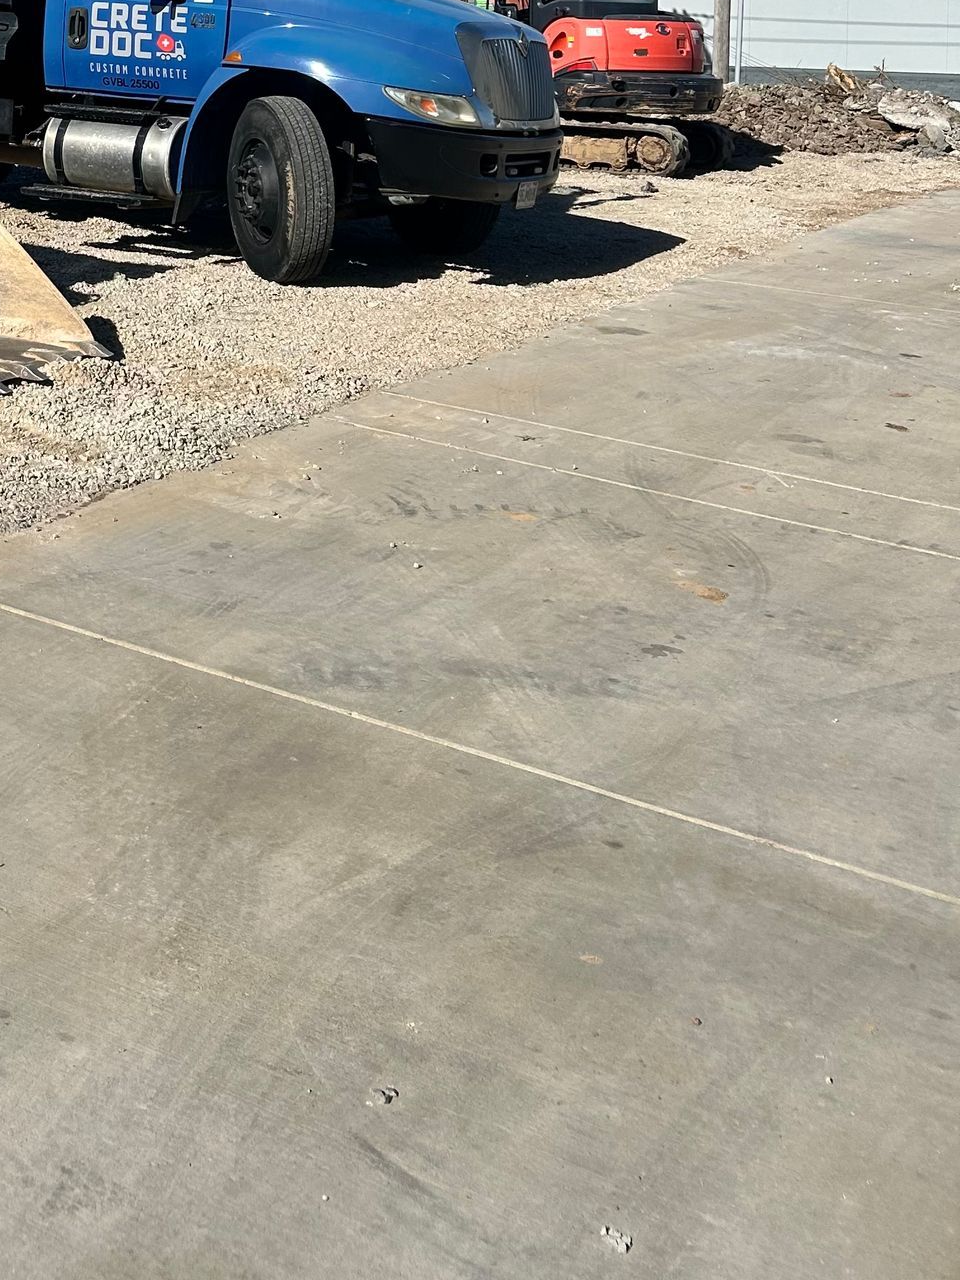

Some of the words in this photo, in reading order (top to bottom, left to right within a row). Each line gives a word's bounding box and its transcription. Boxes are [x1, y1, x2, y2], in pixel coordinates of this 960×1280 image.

[91, 1, 188, 33] CRETE
[90, 29, 153, 59] DOC
[89, 62, 129, 75] CUSTOM
[134, 65, 188, 80] CONCRETE
[130, 78, 160, 90] 25500
